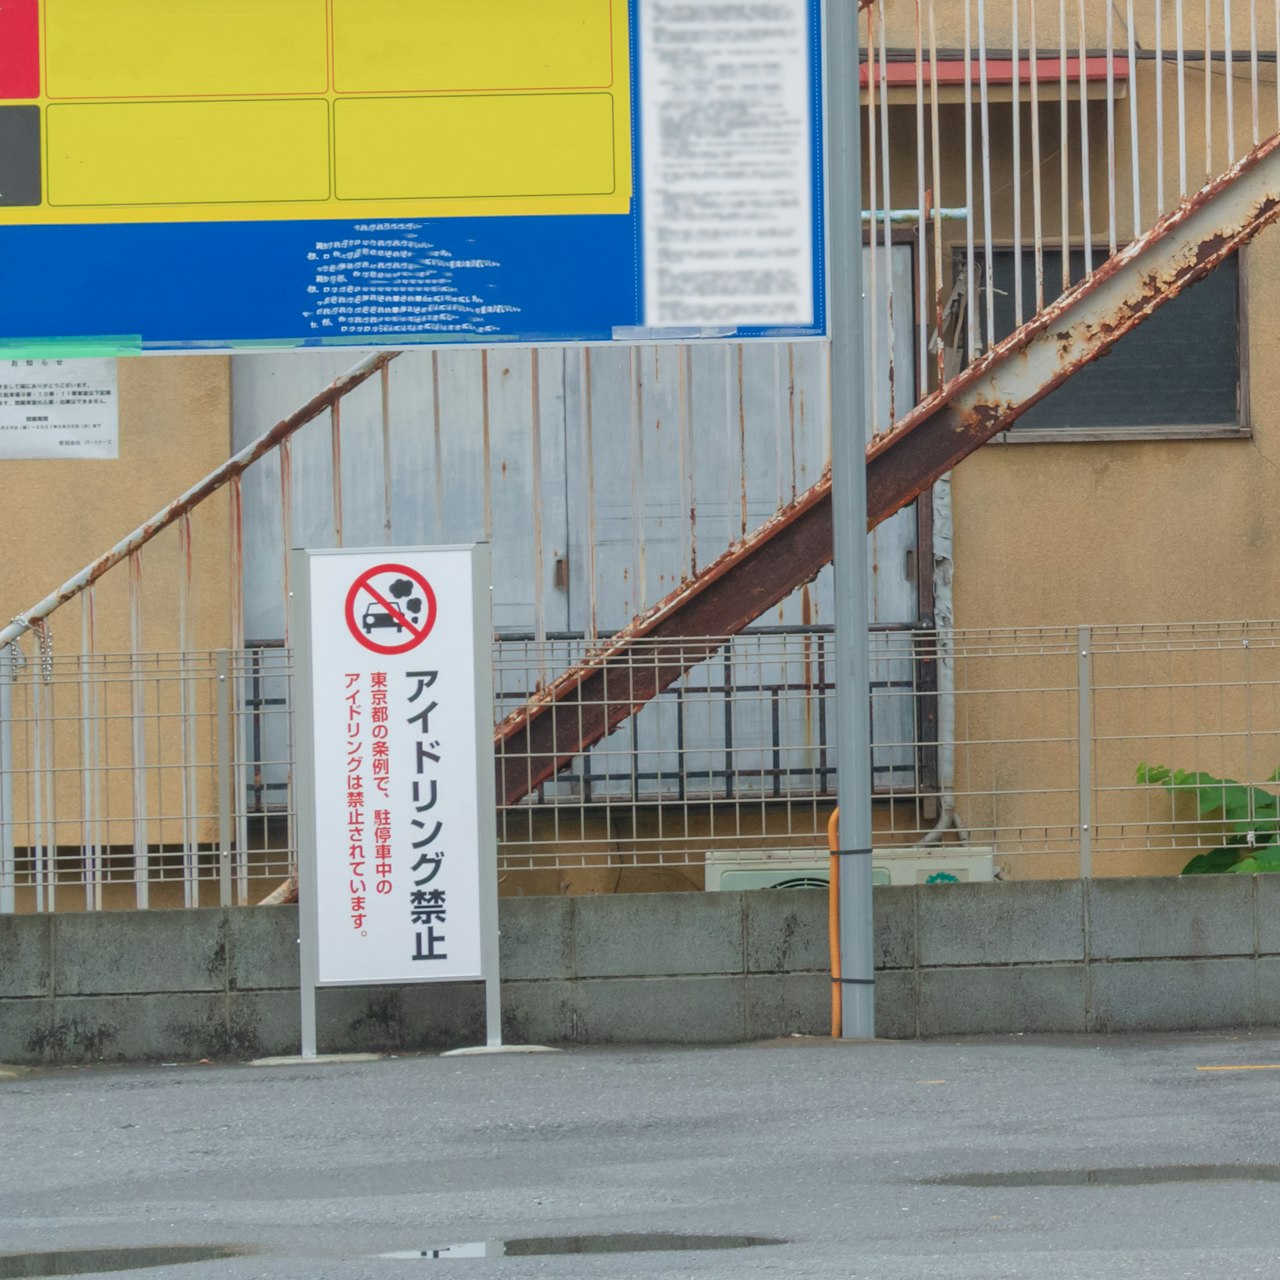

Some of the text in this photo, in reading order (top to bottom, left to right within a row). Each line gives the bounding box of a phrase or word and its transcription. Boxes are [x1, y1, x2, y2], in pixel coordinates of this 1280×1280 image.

[344, 671, 368, 938] アイドリングは禁止されています。
[370, 671, 393, 895] 東京都の条例で、駐停車中の
[405, 670, 448, 961] アイドリング禁止
